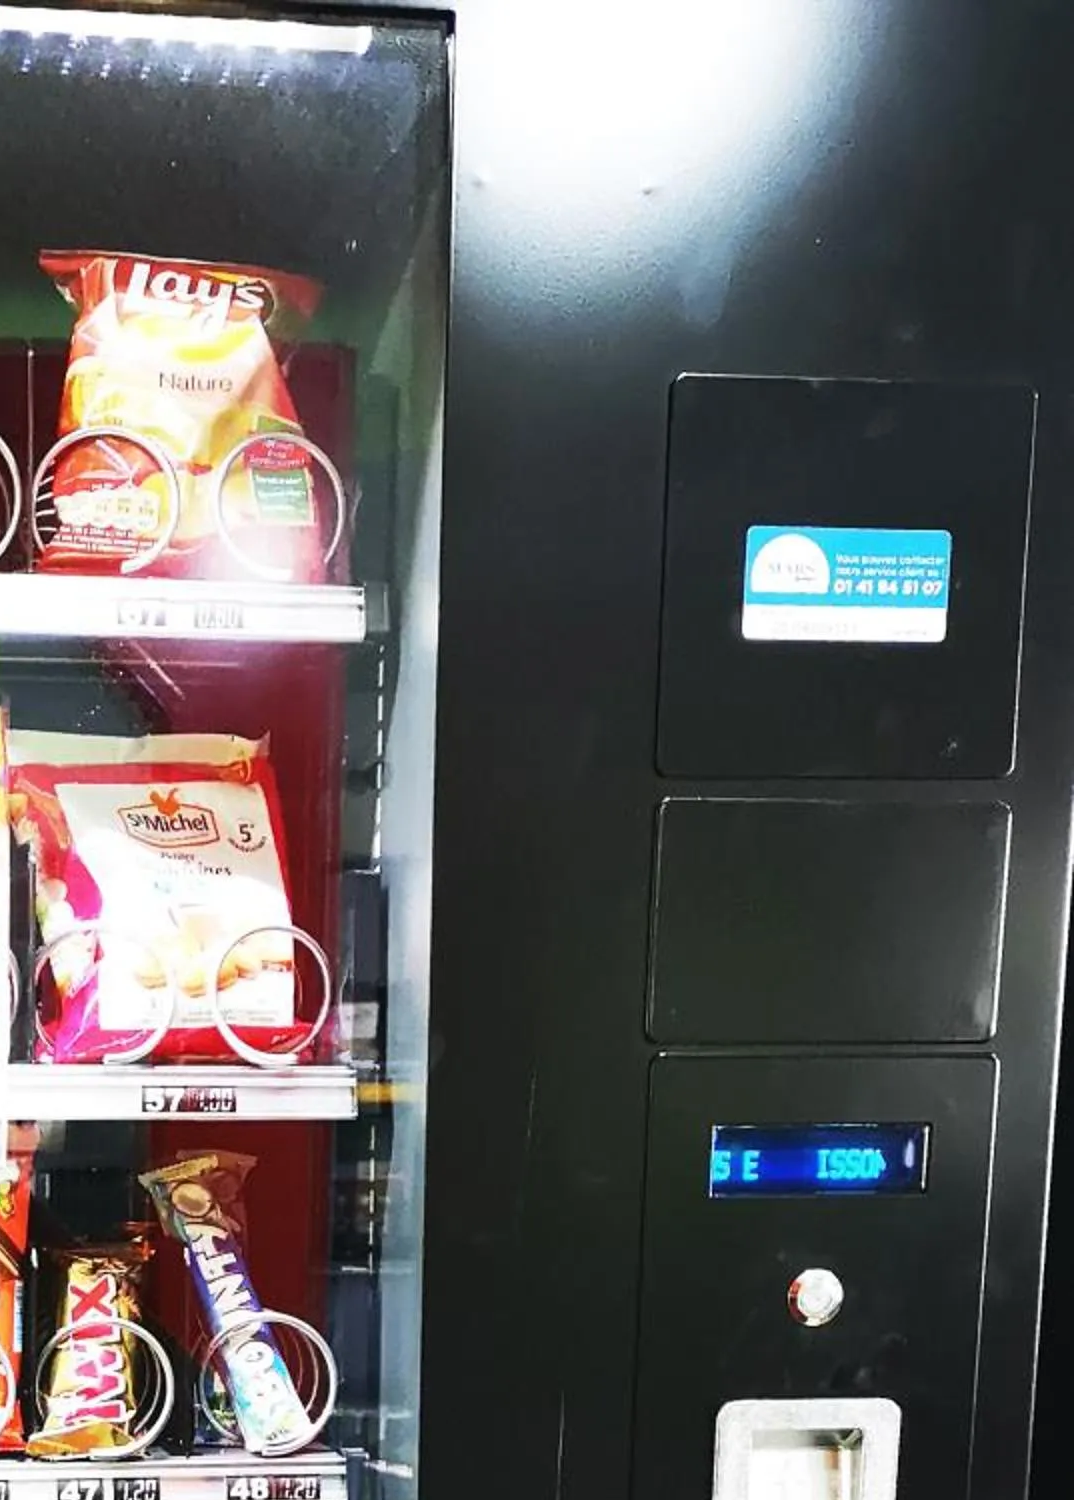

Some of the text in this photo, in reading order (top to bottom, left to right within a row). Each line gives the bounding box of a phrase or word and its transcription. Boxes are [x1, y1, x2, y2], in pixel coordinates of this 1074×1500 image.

[158, 370, 234, 394] Nature
[143, 812, 209, 833] Michel
[143, 1087, 186, 1112] 57
[65, 1275, 125, 1427] TWIX
[228, 1476, 318, 1500] 48 1.20
